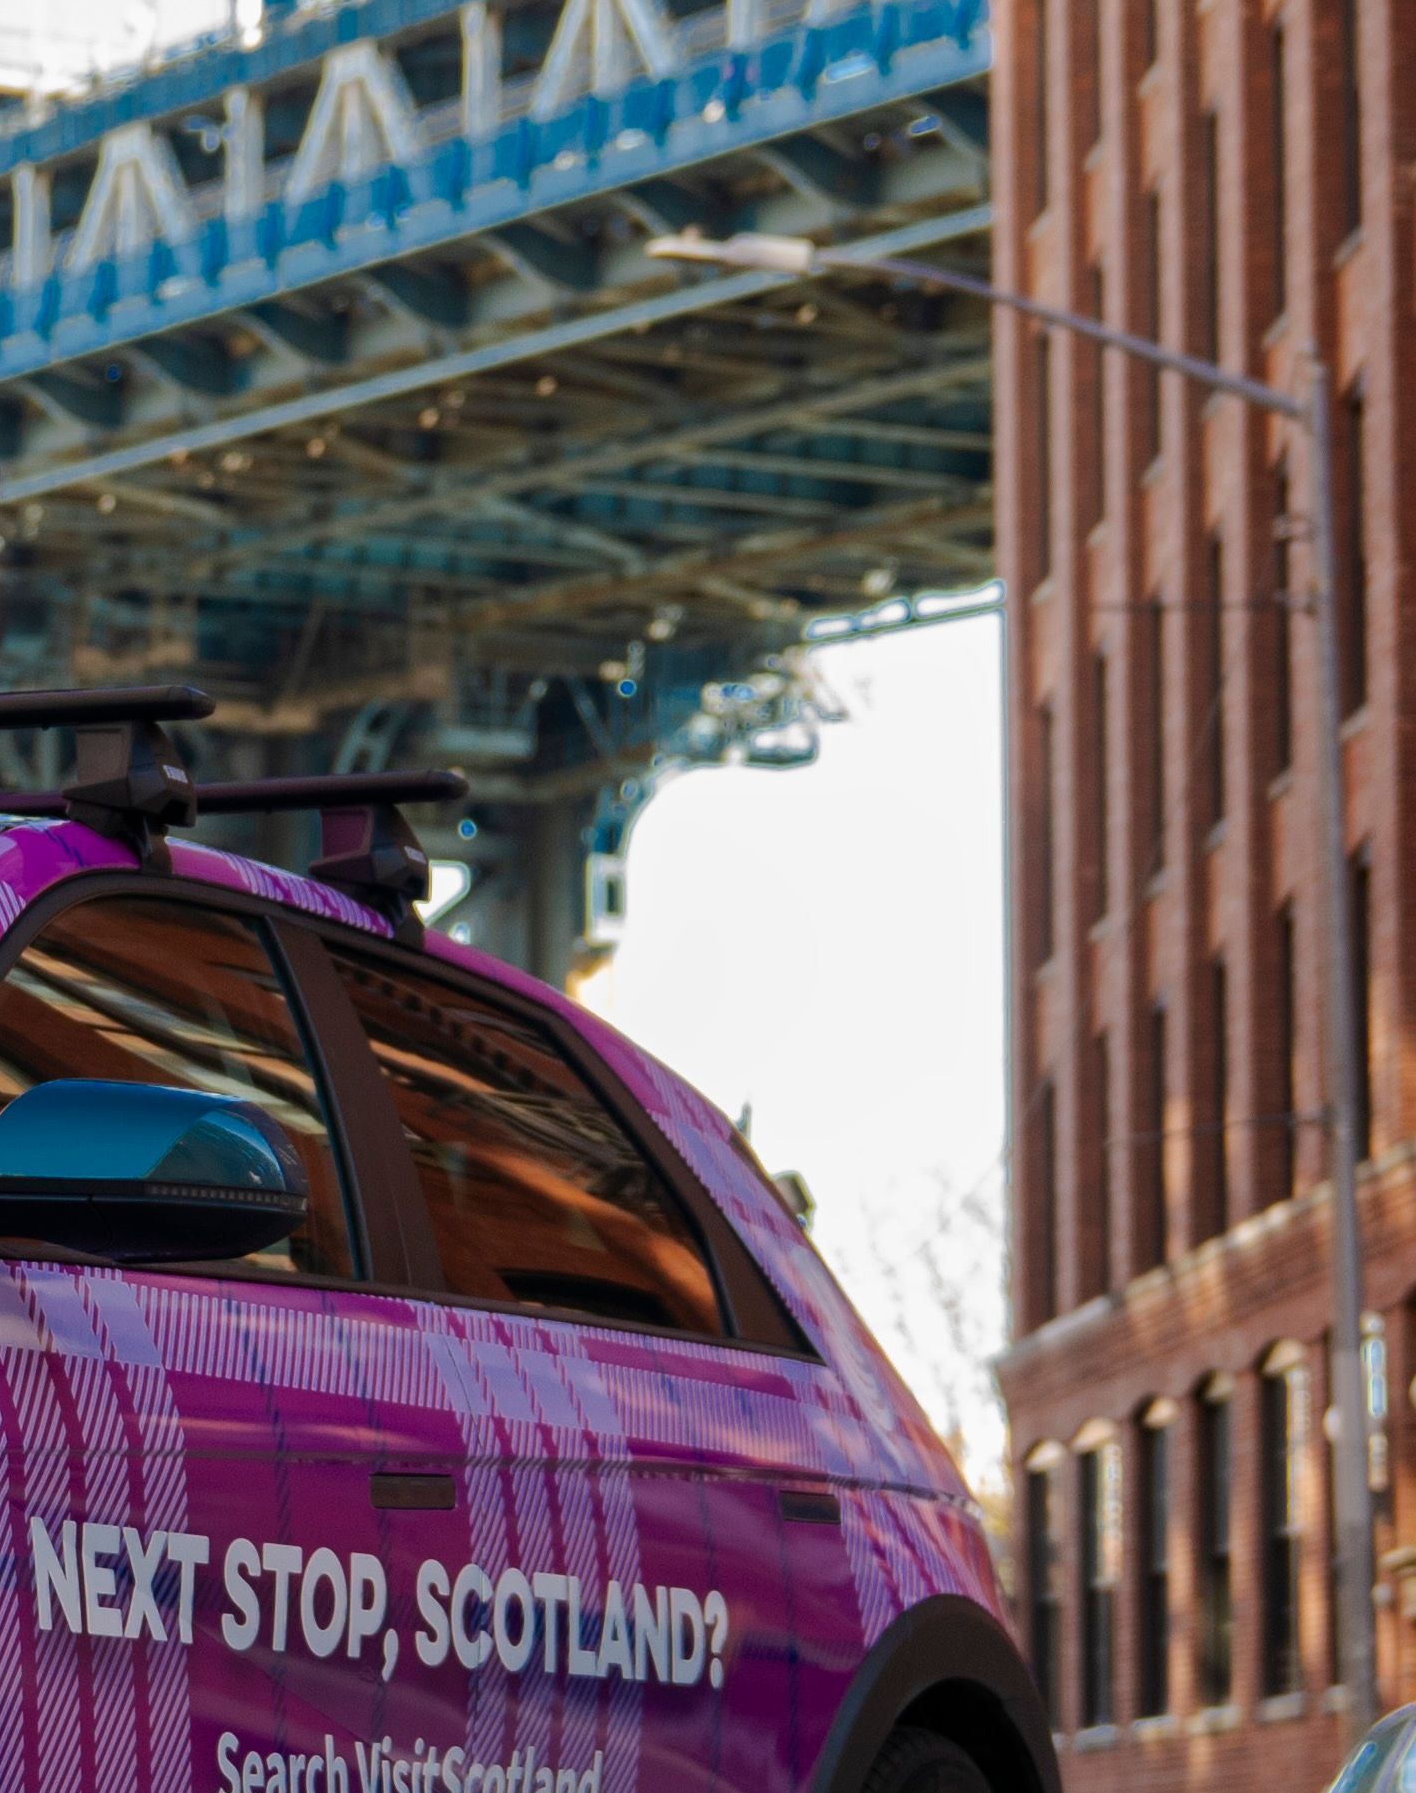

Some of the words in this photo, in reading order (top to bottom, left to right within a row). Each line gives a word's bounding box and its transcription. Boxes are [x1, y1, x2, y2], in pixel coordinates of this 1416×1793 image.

[30, 1515, 210, 1645] NEXT
[221, 1537, 399, 1681] STOP,
[415, 1558, 728, 1689] SCOTLAND?
